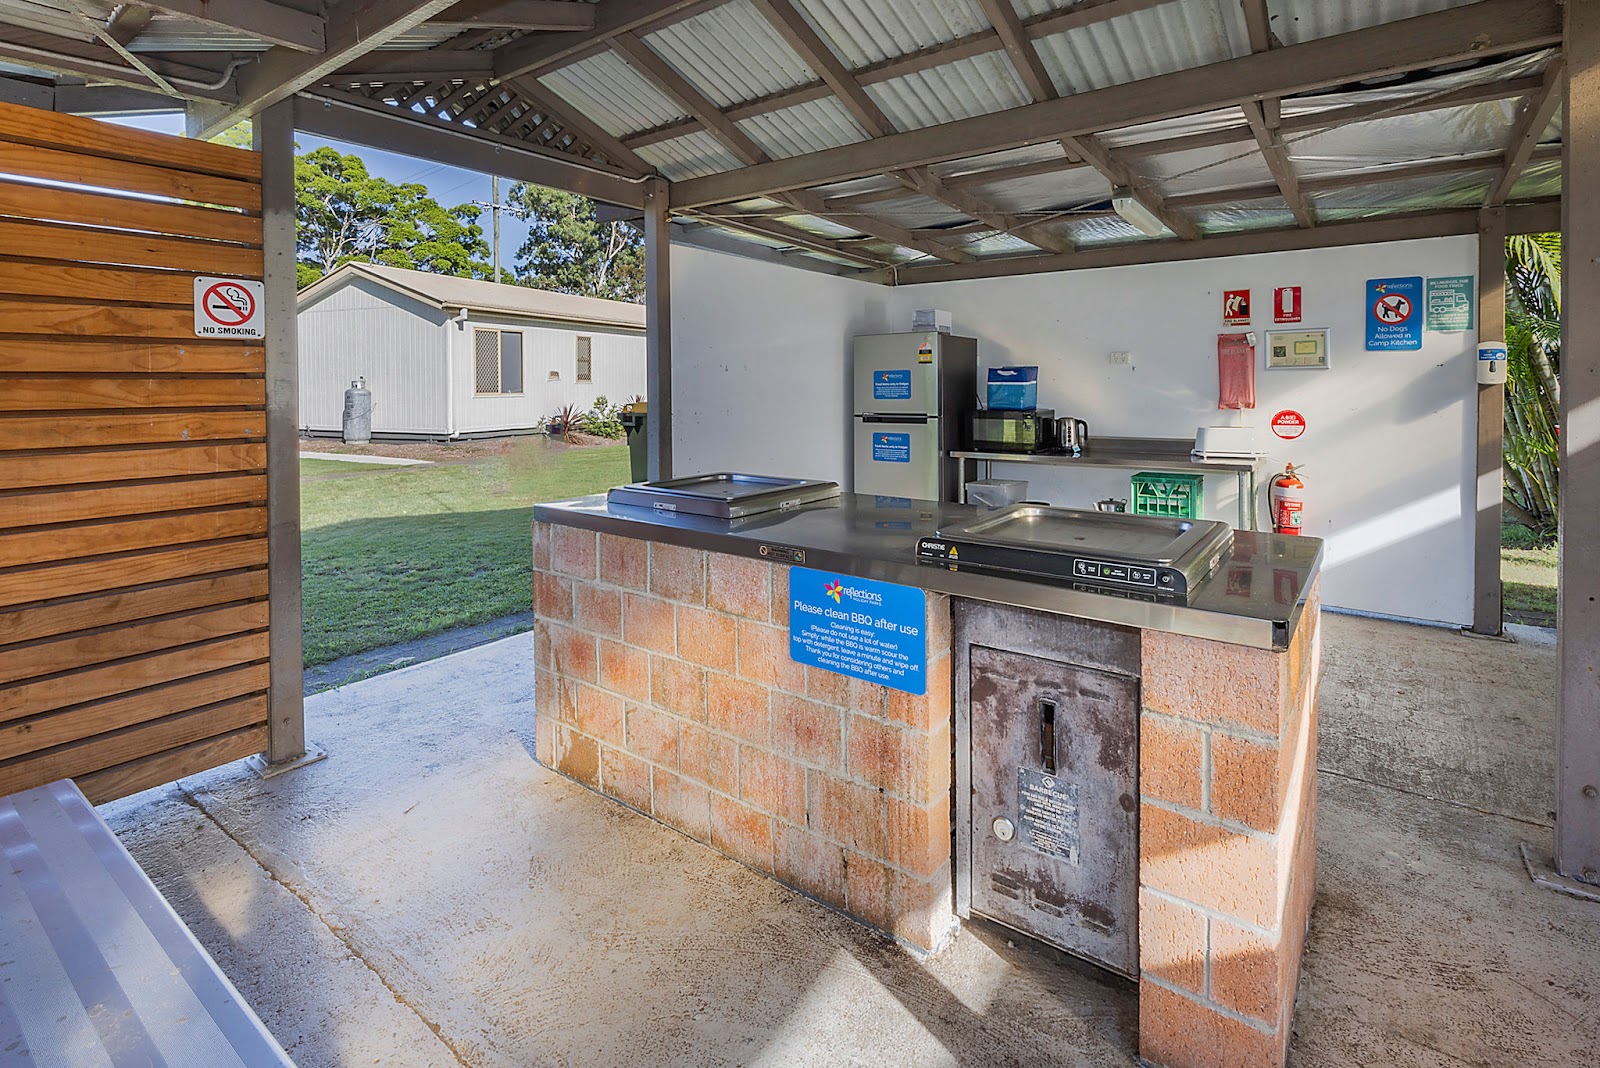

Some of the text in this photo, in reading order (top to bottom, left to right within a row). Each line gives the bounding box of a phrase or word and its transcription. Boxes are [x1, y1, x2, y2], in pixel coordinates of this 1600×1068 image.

[218, 327, 256, 336] SMOKING
[922, 542, 945, 550] CHRISTIE
[843, 586, 882, 602] reflections
[794, 600, 918, 636] Please clean BBQ after use
[830, 622, 854, 634] Cleaning
[810, 625, 829, 635] (Please
[879, 642, 898, 650] water)
[802, 637, 813, 645] with
[841, 646, 856, 656] leave
[861, 652, 881, 663] minute
[882, 657, 893, 665] and
[894, 661, 909, 669] wipe
[806, 645, 821, 655] Thank
[840, 655, 872, 668] considering
[873, 662, 892, 672] others
[845, 640, 858, 649] BBQ
[898, 653, 908, 661] the
[818, 656, 840, 668] cleaning
[851, 664, 863, 673] BBQ
[864, 668, 877, 677] after
[1030, 784, 1068, 800] BARBECUE
